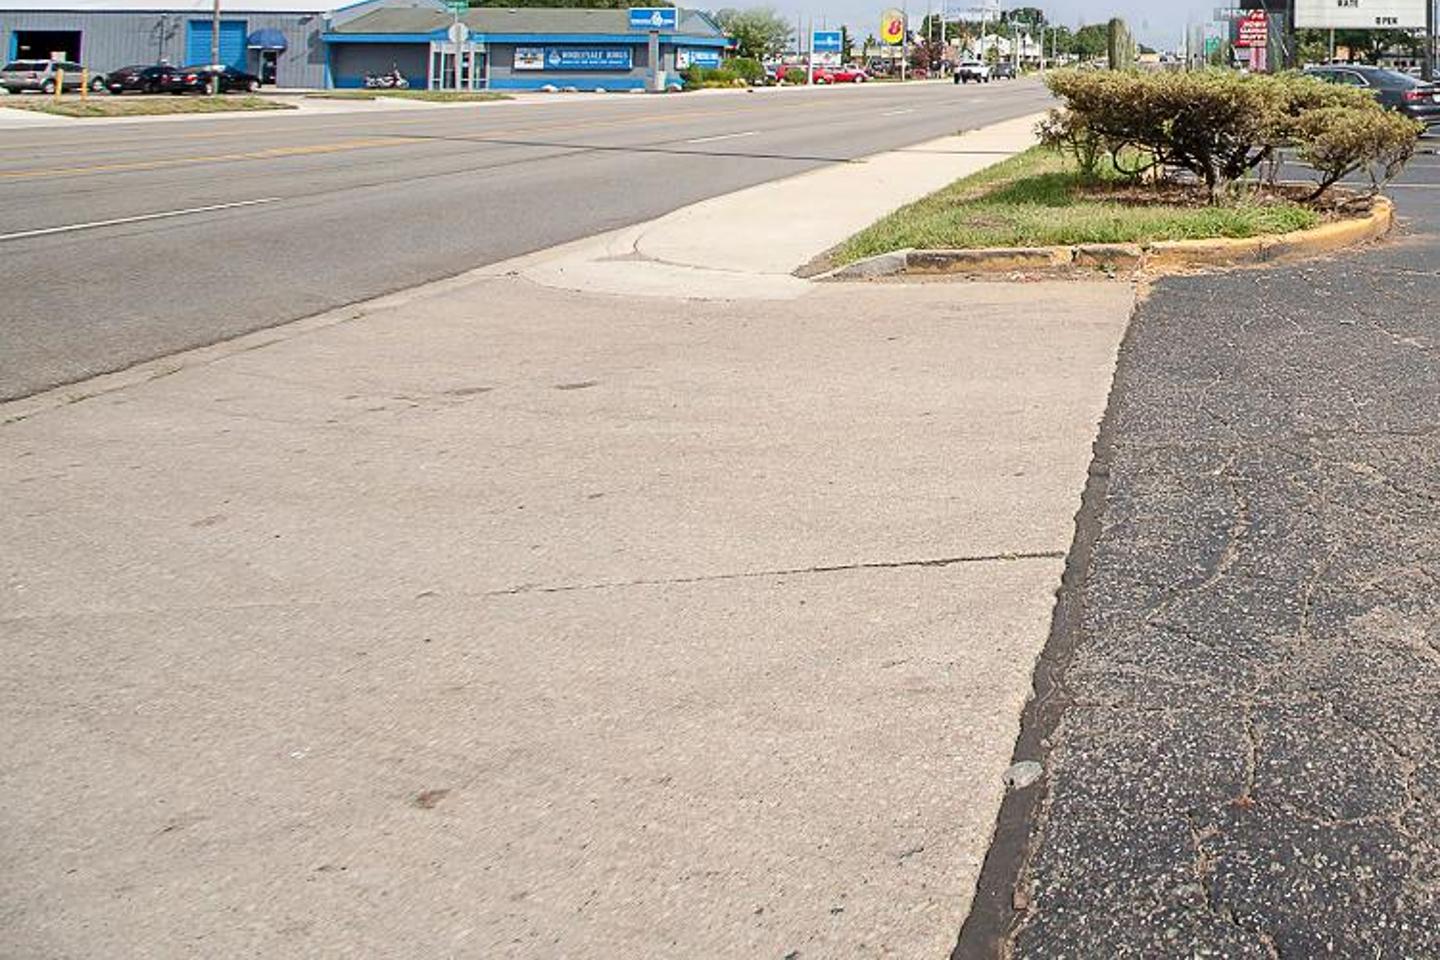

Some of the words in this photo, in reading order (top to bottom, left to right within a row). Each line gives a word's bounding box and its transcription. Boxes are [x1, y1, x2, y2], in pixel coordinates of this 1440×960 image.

[1337, 0, 1359, 8] RATE
[1375, 16, 1399, 26] OPEN
[889, 19, 902, 36] 8
